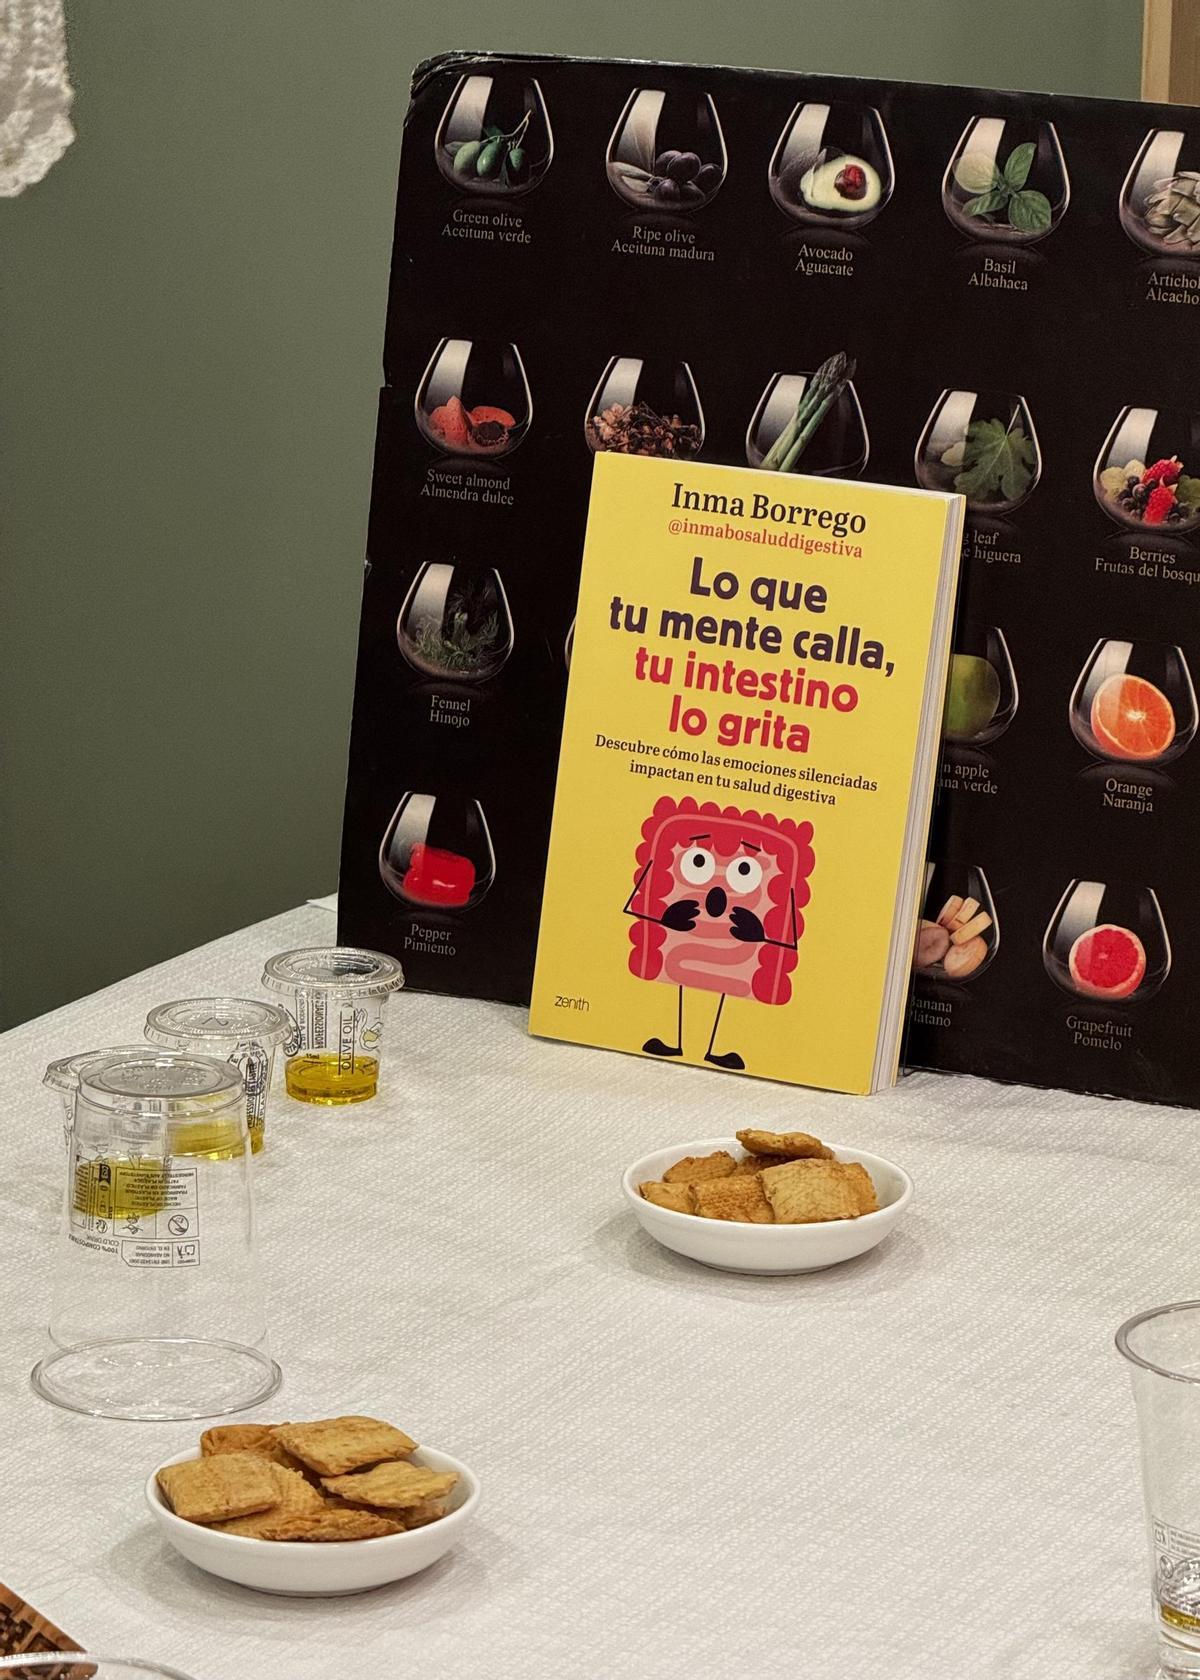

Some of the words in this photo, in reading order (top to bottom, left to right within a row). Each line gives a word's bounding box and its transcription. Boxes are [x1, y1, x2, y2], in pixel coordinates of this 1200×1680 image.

[453, 209, 489, 227] Green
[492, 212, 522, 228] olive
[442, 223, 496, 241] Aceituna
[499, 228, 531, 244] verde
[633, 225, 661, 244] Ripe
[664, 228, 695, 245] olive
[611, 239, 665, 257] Aceituna
[669, 244, 715, 262] madura
[798, 244, 853, 261] Avocado
[796, 258, 854, 277] Aguacate
[984, 258, 1016, 275] Basil
[968, 272, 1028, 291] Albahaca
[1145, 287, 1200, 305] Alcacho
[427, 468, 463, 487] Sweet
[466, 471, 510, 491] almond
[420, 484, 481, 502] Almendra
[483, 488, 514, 505] dulce
[672, 483, 744, 517] Inma
[751, 494, 866, 537] Borrego
[668, 518, 863, 558] @inmabosaluddigestiva
[974, 530, 999, 545] leaf
[974, 545, 1021, 563] higuera
[1129, 546, 1176, 564] Berries
[1095, 557, 1135, 575] Frutas
[1138, 563, 1158, 577] del
[1163, 565, 1200, 585] bosqu
[690, 556, 739, 600] Lo
[750, 576, 828, 613] que
[610, 596, 648, 633] tu
[659, 608, 782, 653] mente
[793, 625, 895, 677] calla,
[635, 646, 673, 684] tu
[683, 651, 858, 712] intestino
[430, 695, 471, 712] Fennel
[429, 709, 470, 729] Hinojo
[668, 694, 707, 736] lo
[718, 709, 810, 753] grita
[594, 733, 661, 757] Descubre
[662, 744, 699, 765] cómo
[701, 748, 721, 767] las
[723, 754, 797, 779] emociones
[798, 766, 878, 792] silenciadas
[955, 764, 989, 780] apple
[629, 758, 695, 785] impactan
[696, 773, 714, 787] en
[716, 774, 731, 789] tu
[733, 774, 771, 796] salud
[772, 781, 836, 805] digestiva
[963, 780, 998, 795] verde
[1105, 777, 1153, 798] Orange
[1102, 793, 1154, 813] Naranja
[411, 923, 452, 942] Pepper
[403, 936, 457, 956] Pimiento
[555, 995, 590, 1012] zenith
[342, 1015, 353, 1034] OIL
[909, 1009, 951, 1027] látano
[1066, 1015, 1132, 1038] Grapefruit
[1074, 1031, 1122, 1052] Pomelo
[342, 1037, 352, 1070] OLIVE
